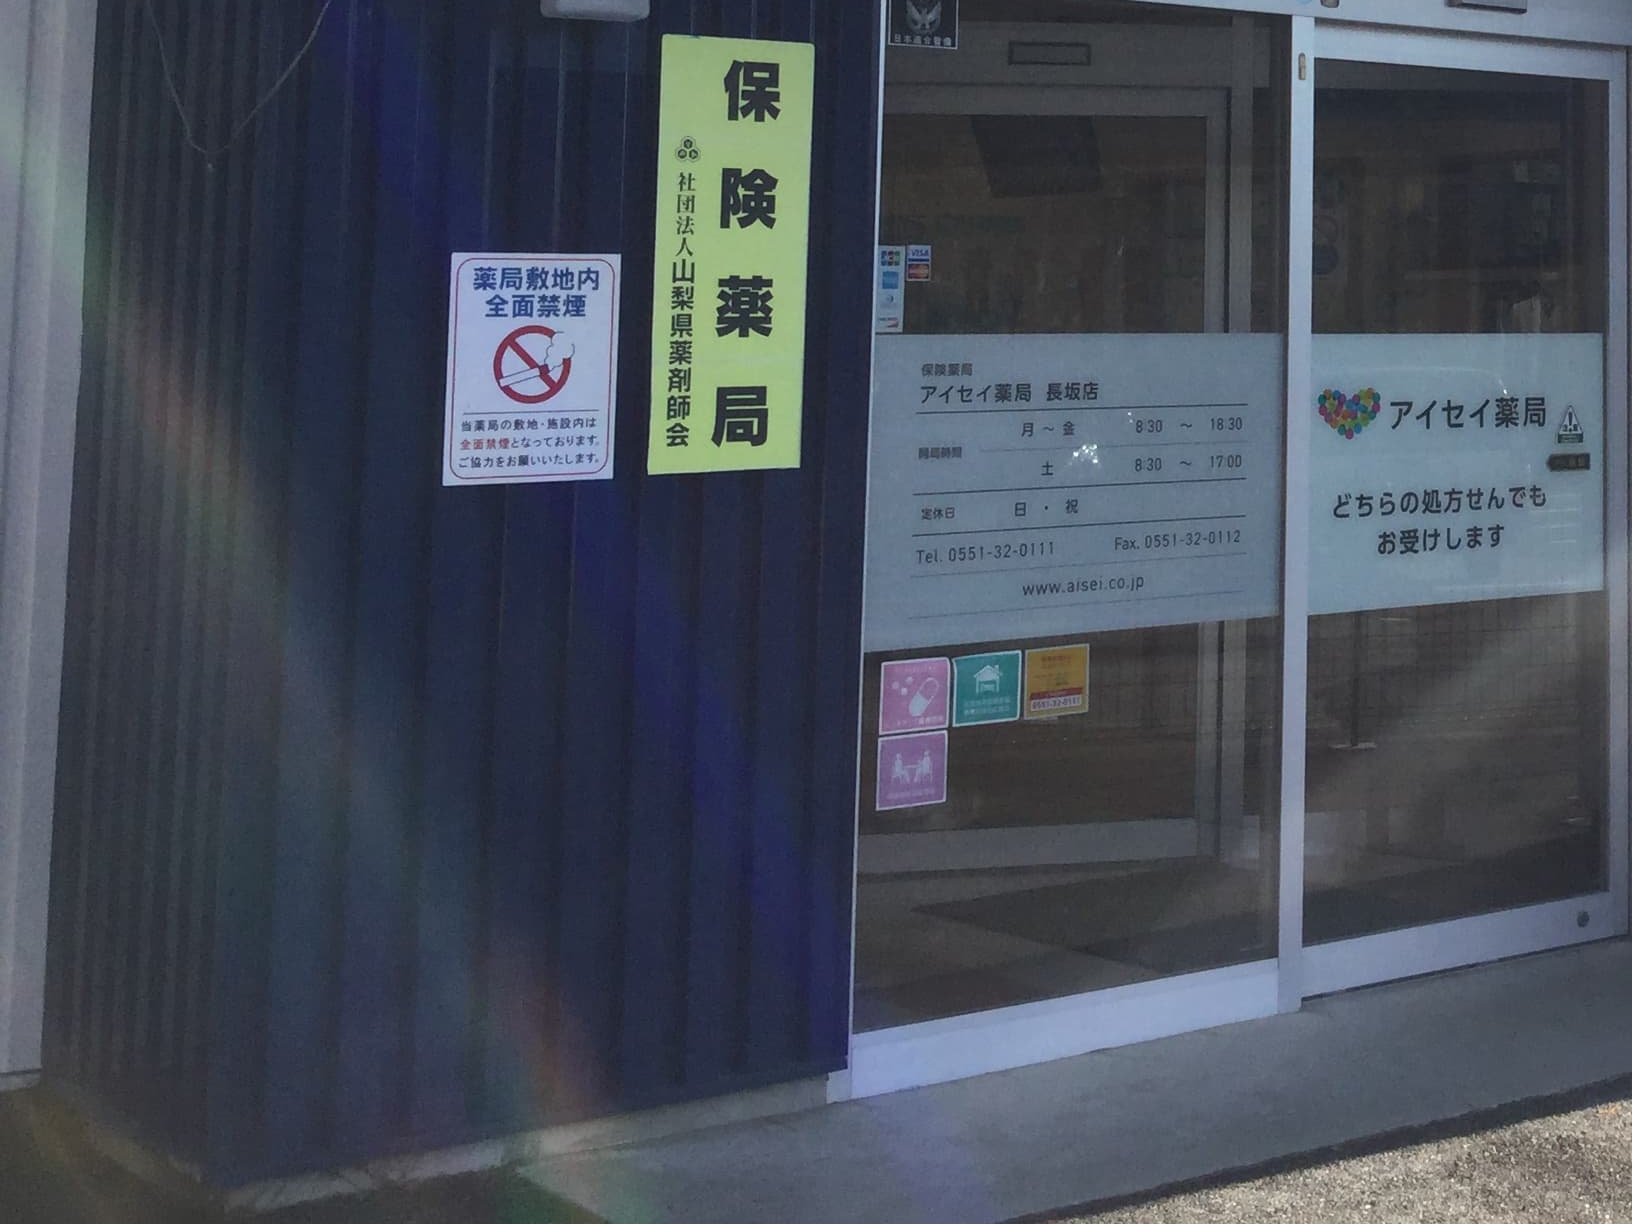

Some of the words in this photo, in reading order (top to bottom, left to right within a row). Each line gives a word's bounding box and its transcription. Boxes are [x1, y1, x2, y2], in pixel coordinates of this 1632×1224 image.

[711, 59, 781, 448] 保険薬局
[473, 267, 600, 291] 薬局敷地内
[485, 294, 587, 318] 全面禁煙
[665, 171, 697, 449] 社団法人山梨県薬剤師会
[920, 383, 1032, 403] アイセイ薬局
[1046, 381, 1099, 401] 長坂店
[1390, 397, 1546, 429] アイセイ薬局
[921, 506, 956, 520] 定休日
[1333, 484, 1547, 519] どちらの処方せんでも
[1114, 536, 1141, 551] Fax.
[1144, 529, 1242, 550] 0551-32-0112
[1377, 524, 1505, 555] お受けします
[916, 549, 943, 564] Tel.
[948, 541, 1055, 562] 0551-32-0111
[1022, 575, 1145, 597] www.aisei.co.jp
